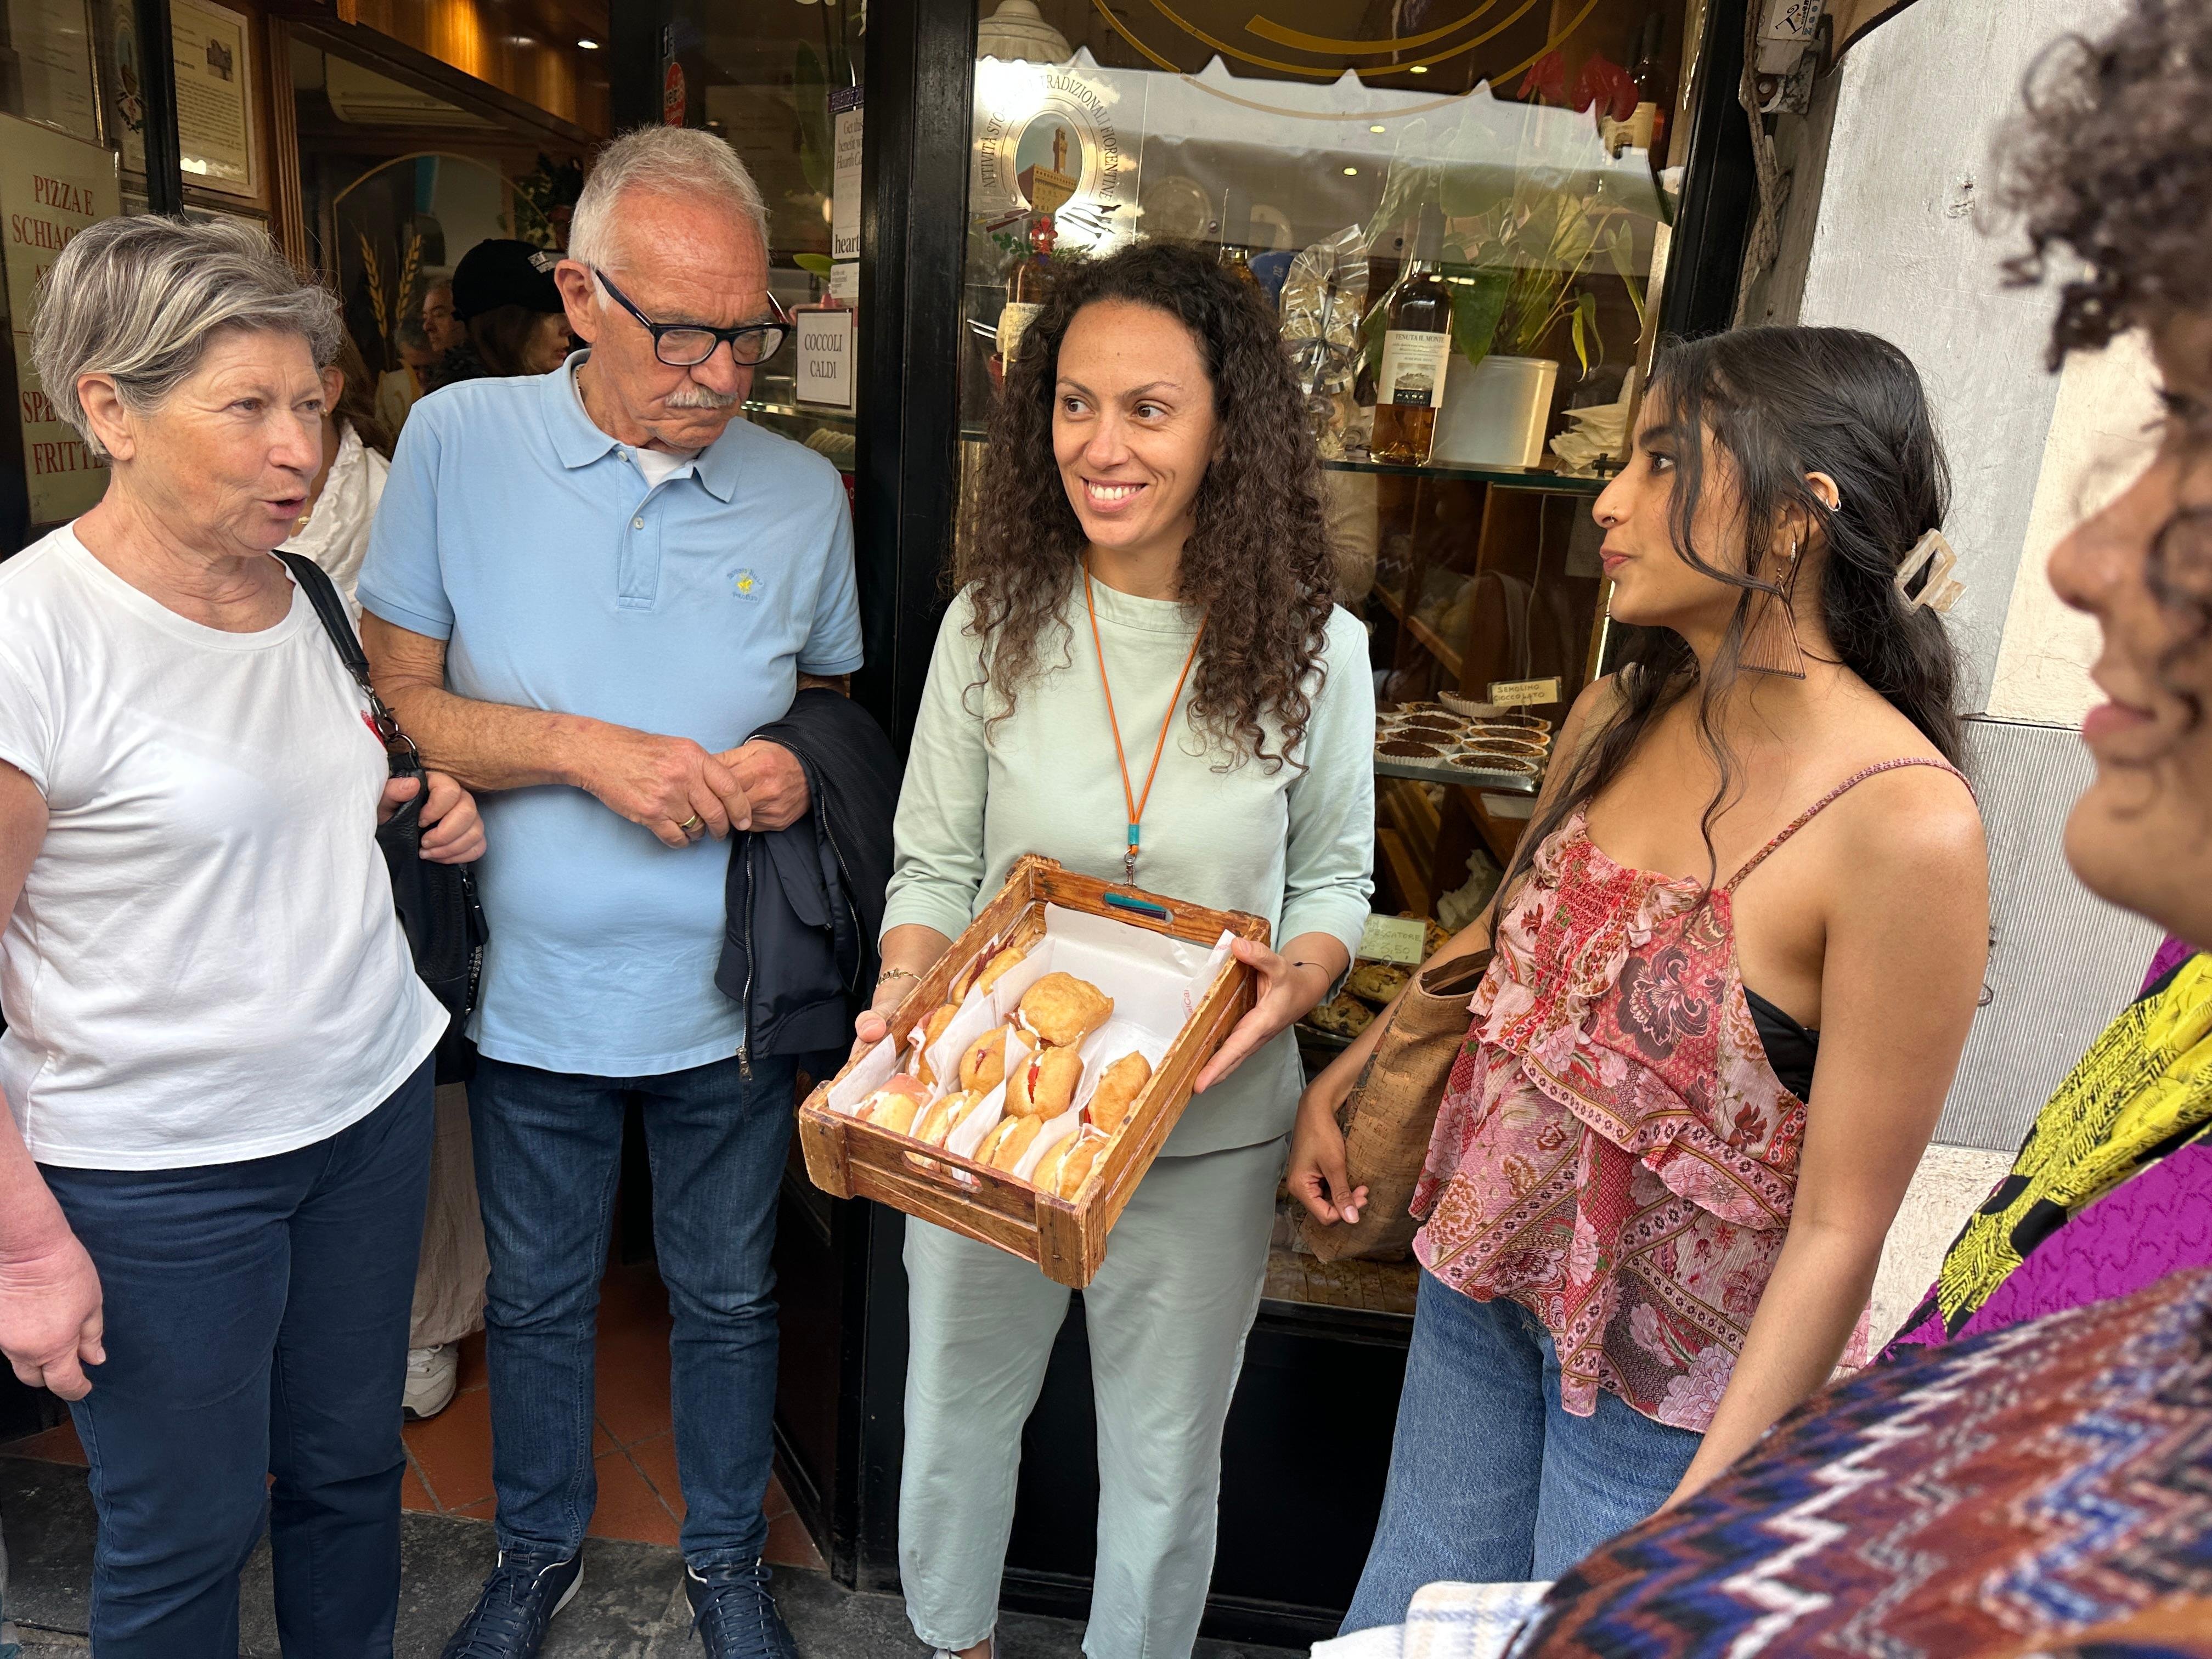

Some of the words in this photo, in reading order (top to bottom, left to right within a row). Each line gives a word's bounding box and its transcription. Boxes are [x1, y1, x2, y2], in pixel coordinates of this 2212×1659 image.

[1040, 74, 1110, 126] TRADIZIONALI
[1098, 124, 1118, 201] FIORENTINE
[33, 174, 82, 213] PIZZA
[84, 189, 94, 216] E
[12, 214, 82, 251] SCHIAC
[804, 334, 842, 352] COCCOLI
[1395, 333, 1419, 341] TENUTA
[810, 360, 837, 379] CALDI
[1497, 684, 1539, 693] SEMOLINO
